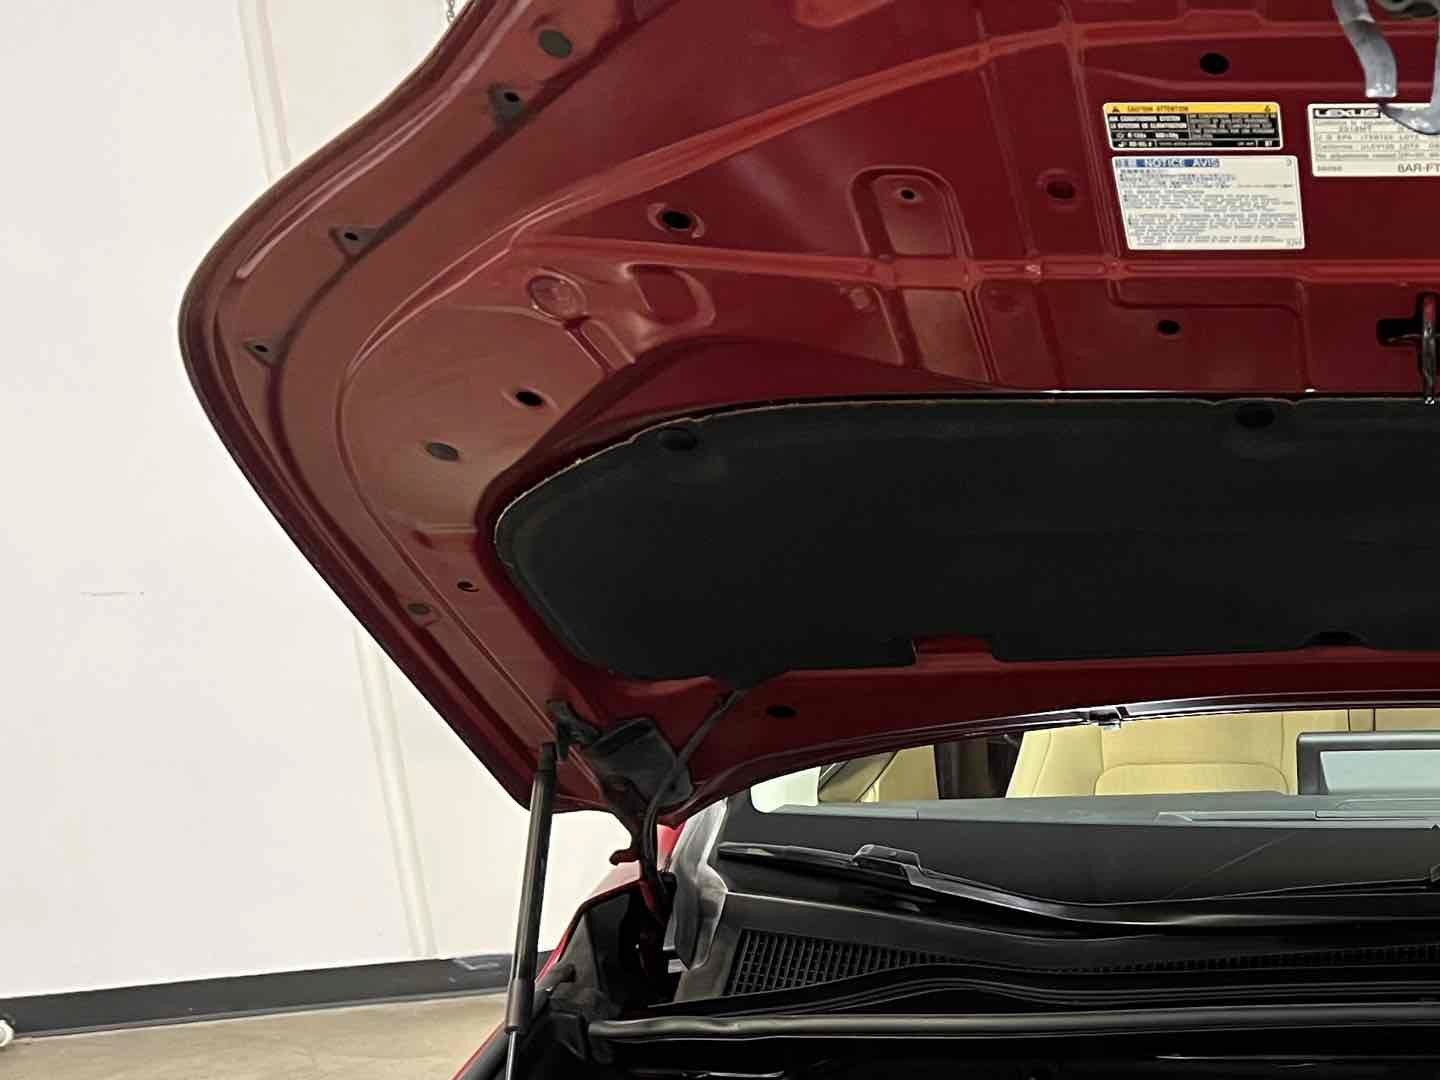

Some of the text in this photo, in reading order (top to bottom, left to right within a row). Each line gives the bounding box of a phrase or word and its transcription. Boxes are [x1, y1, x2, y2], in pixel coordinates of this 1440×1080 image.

[1314, 108, 1378, 117] LEXUS
[1144, 159, 1184, 168] NOTICE
[1193, 159, 1220, 168] AVIS
